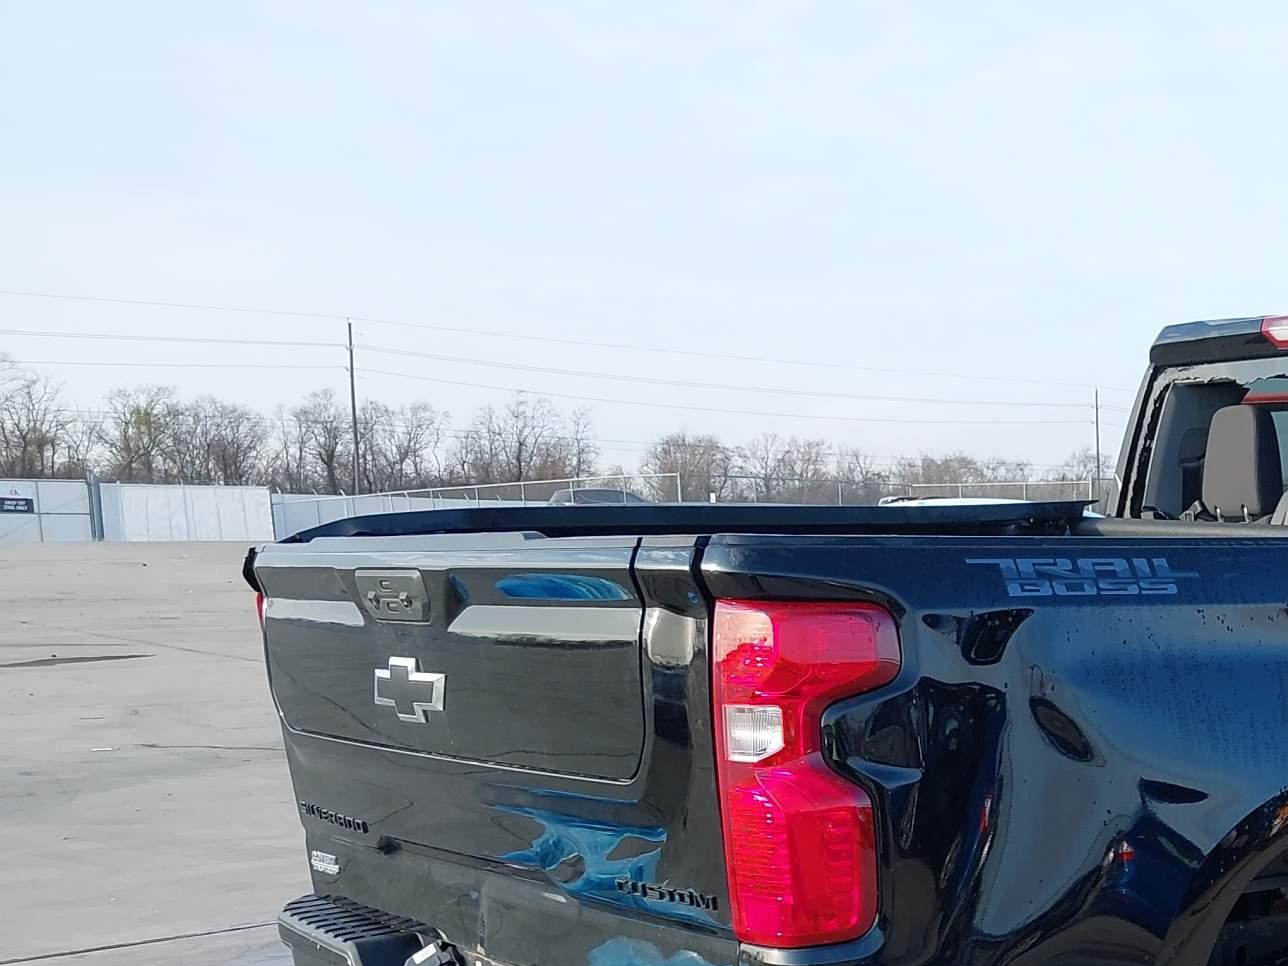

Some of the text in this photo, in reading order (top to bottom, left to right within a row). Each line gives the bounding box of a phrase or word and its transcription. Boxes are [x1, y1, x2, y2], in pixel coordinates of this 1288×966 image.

[965, 558, 1199, 578] TRAIL
[1007, 579, 1178, 597] BOSS
[615, 879, 719, 911] CUSTOM
